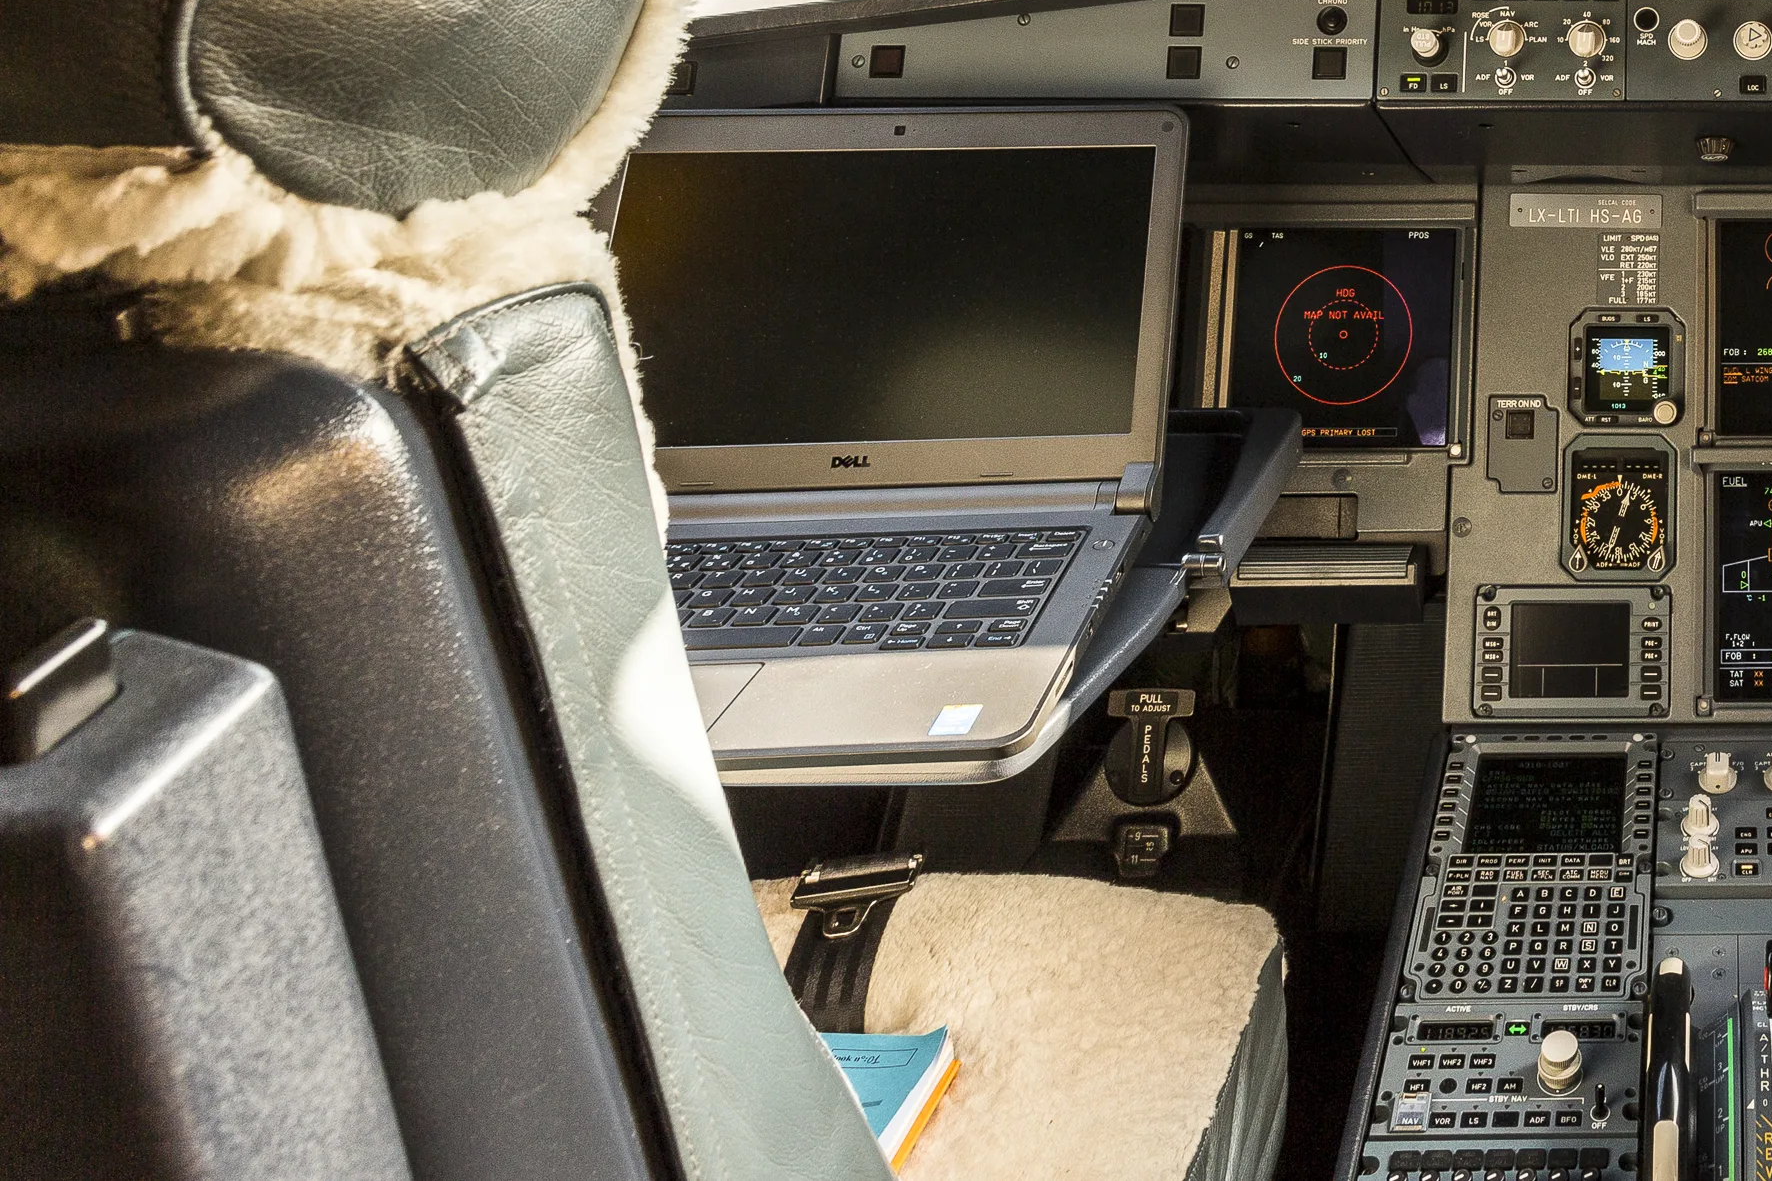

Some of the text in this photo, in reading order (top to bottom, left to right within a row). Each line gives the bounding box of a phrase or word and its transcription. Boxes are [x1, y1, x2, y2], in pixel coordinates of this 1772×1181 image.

[1529, 208, 1642, 223] LX-LTI HS-AG
[1336, 289, 1355, 297] HDG
[1329, 311, 1348, 319] NOT
[1353, 311, 1384, 319] AVAIL
[831, 455, 870, 468] DELL
[1723, 477, 1747, 485] FUEL
[1725, 652, 1741, 660] FOB
[1139, 694, 1163, 703] PULL
[1511, 1095, 1528, 1103] NAV
